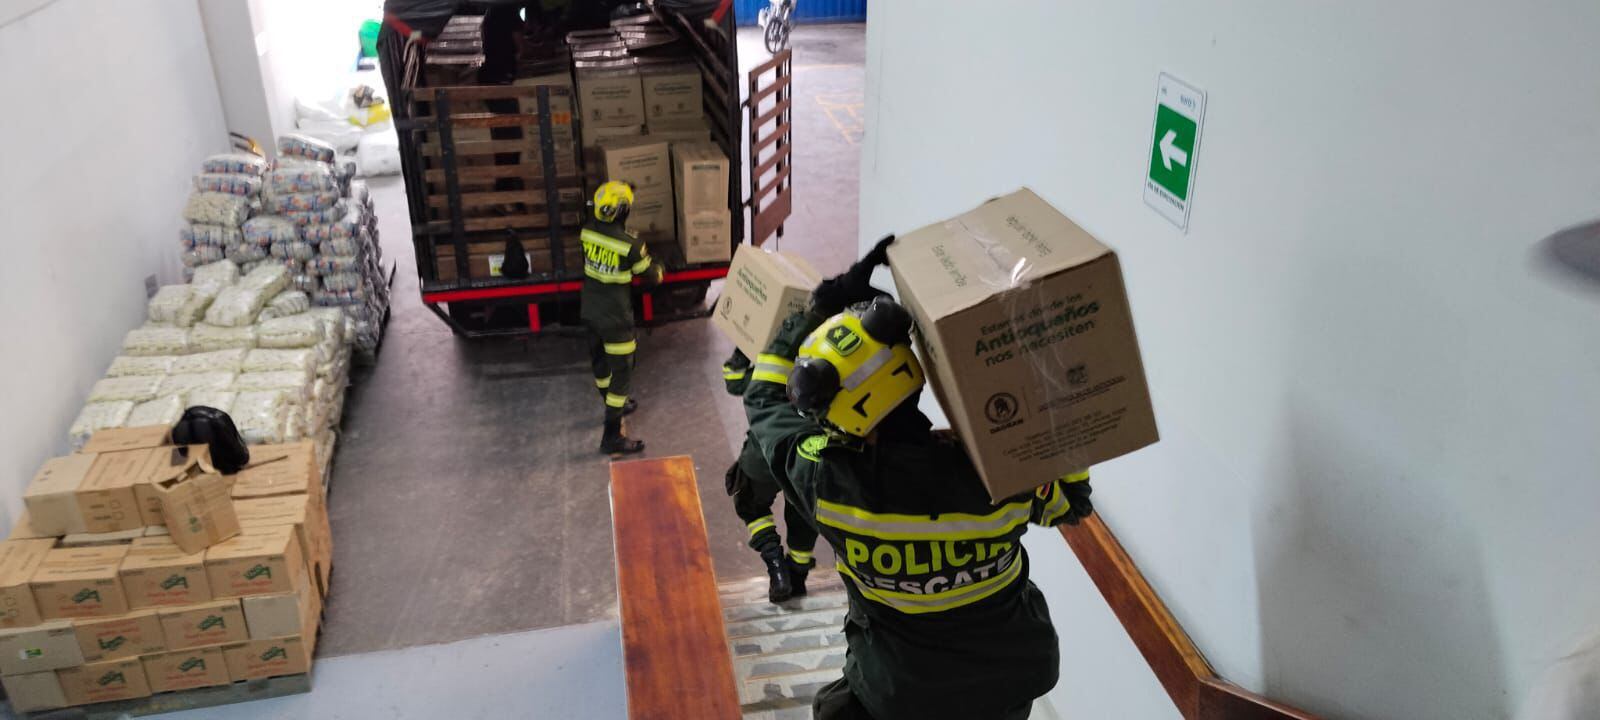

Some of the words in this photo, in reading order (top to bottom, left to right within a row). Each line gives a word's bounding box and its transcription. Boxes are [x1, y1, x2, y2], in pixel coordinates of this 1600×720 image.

[975, 301, 1100, 356] Antioqueños
[985, 350, 1014, 367] nos
[1019, 320, 1096, 355] necesiten
